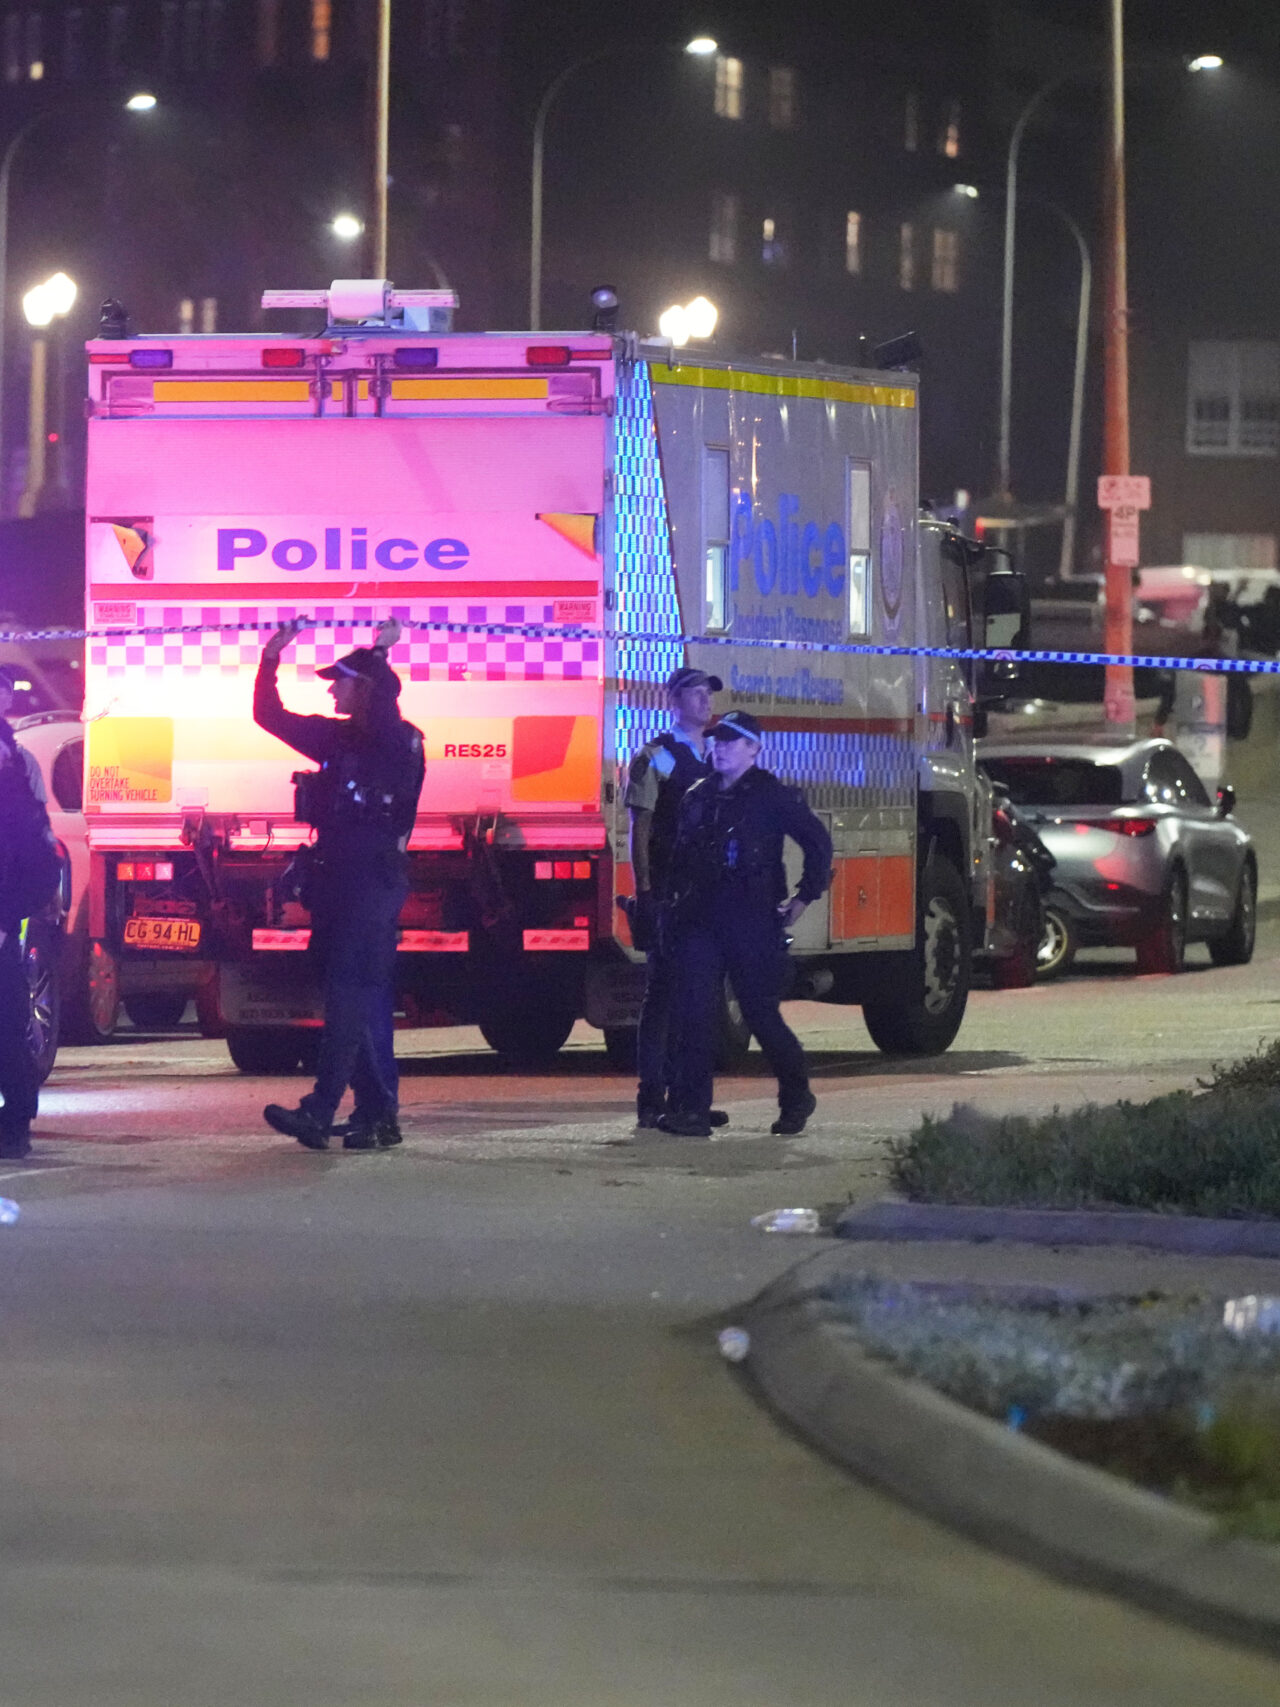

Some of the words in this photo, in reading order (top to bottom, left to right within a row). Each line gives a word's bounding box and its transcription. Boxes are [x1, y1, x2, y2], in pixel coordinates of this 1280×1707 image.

[217, 528, 470, 571] Police
[731, 491, 845, 598] Police
[444, 744, 506, 757] RES25
[90, 766, 101, 777] DO
[104, 766, 119, 777] NOT
[90, 777, 130, 789] OVERTAKE
[90, 789, 123, 801] TURNING
[125, 789, 158, 800] VEHICLE
